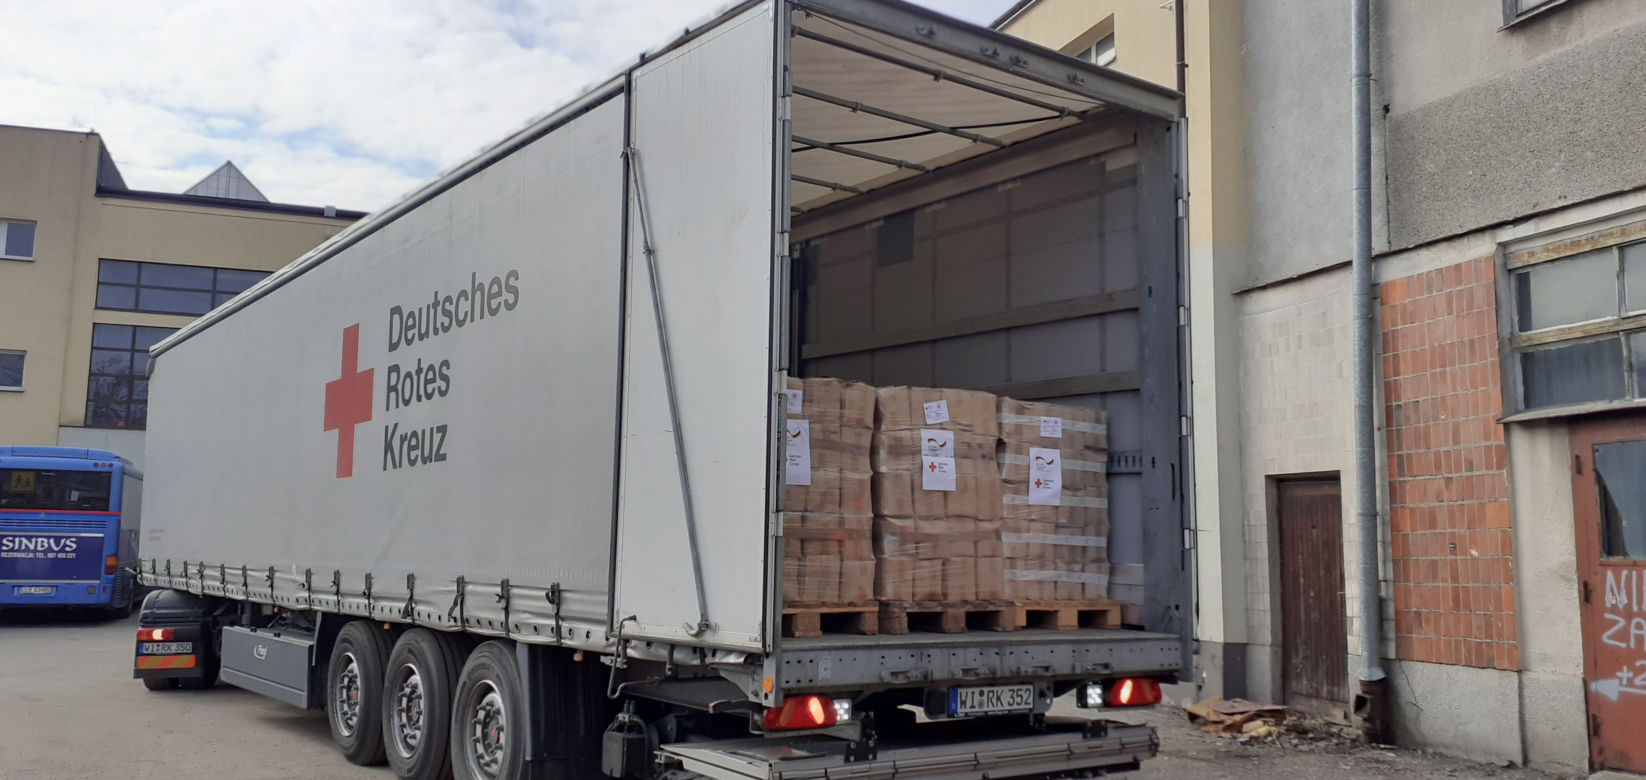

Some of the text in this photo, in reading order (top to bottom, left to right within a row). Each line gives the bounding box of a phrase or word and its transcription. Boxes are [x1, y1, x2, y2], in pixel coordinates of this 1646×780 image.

[388, 269, 519, 352] Deutsches
[386, 358, 450, 412] Rotes
[383, 422, 448, 471] Kreuz
[1, 536, 77, 551] SINBUS
[144, 642, 191, 652] WI RK 350
[959, 687, 1032, 710] WI RK 352
